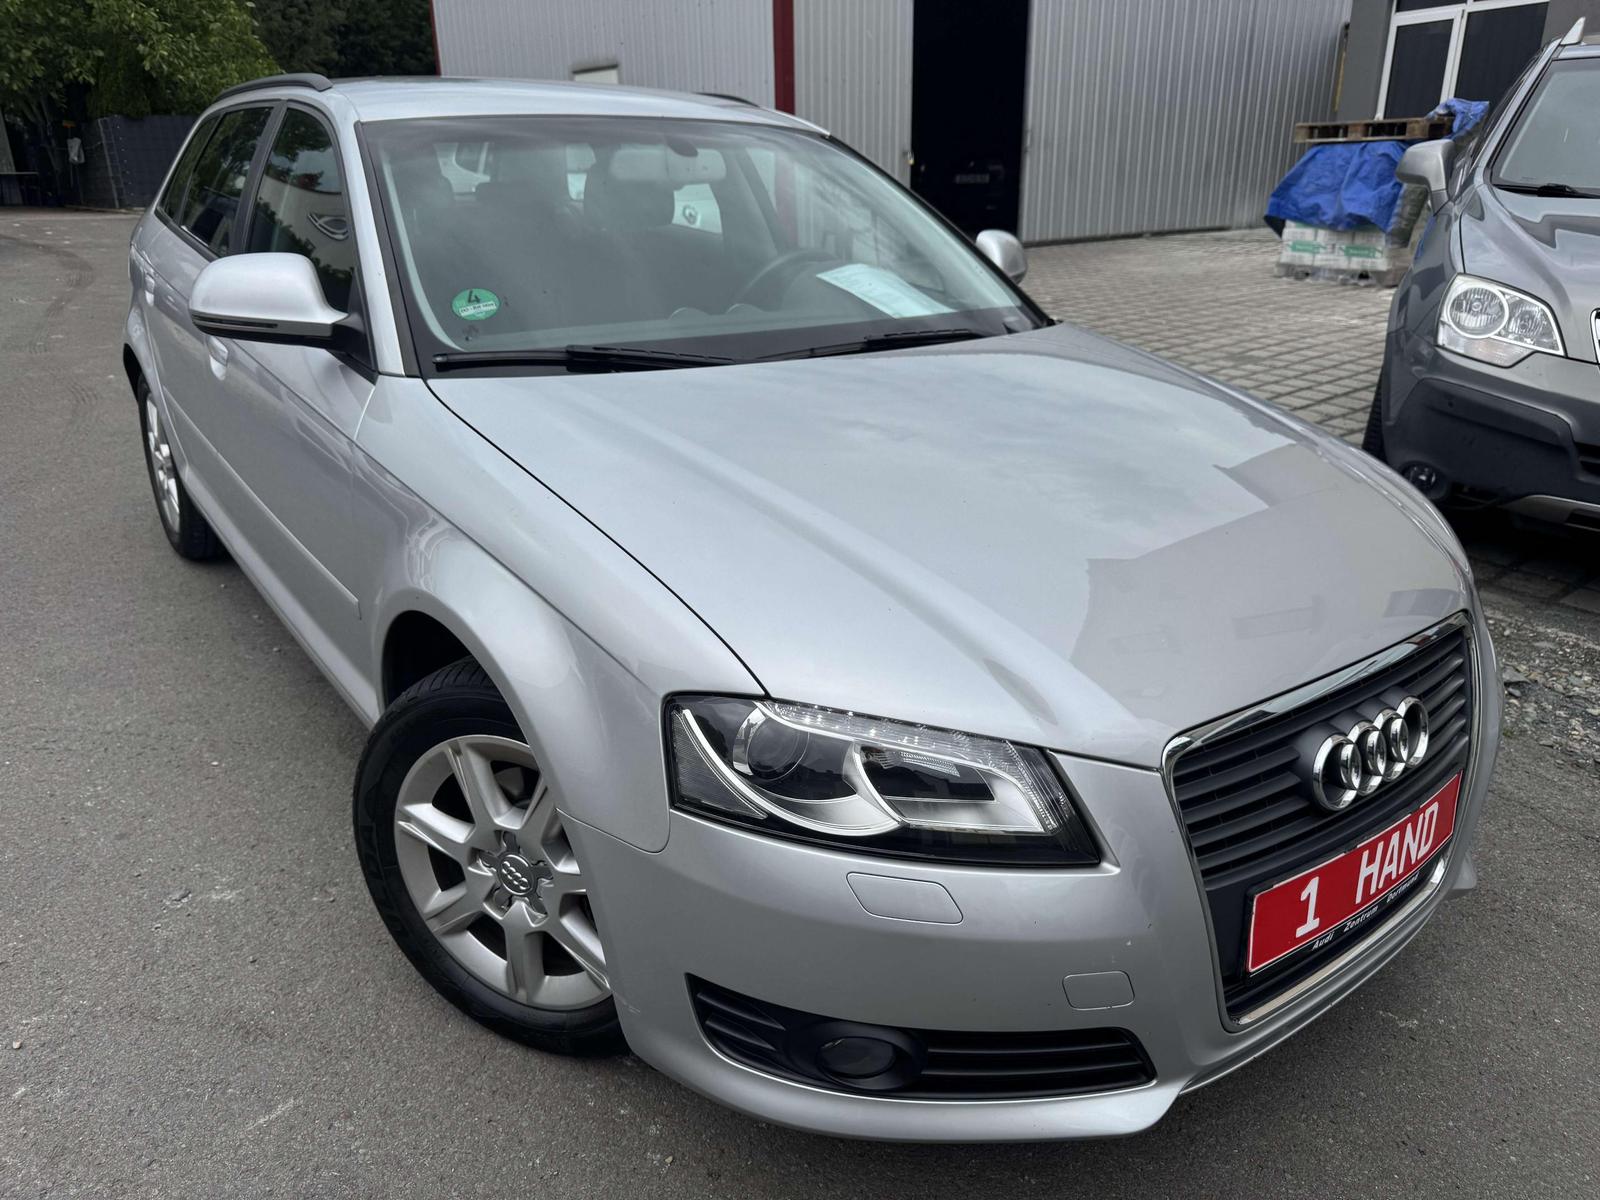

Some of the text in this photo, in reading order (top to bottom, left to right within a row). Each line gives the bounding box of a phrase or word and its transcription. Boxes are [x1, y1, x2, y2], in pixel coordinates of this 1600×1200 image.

[467, 289, 481, 304] 4
[1295, 801, 1439, 938] 1 HAND
[1311, 931, 1335, 951] Audi
[1343, 905, 1379, 933] Zentrum
